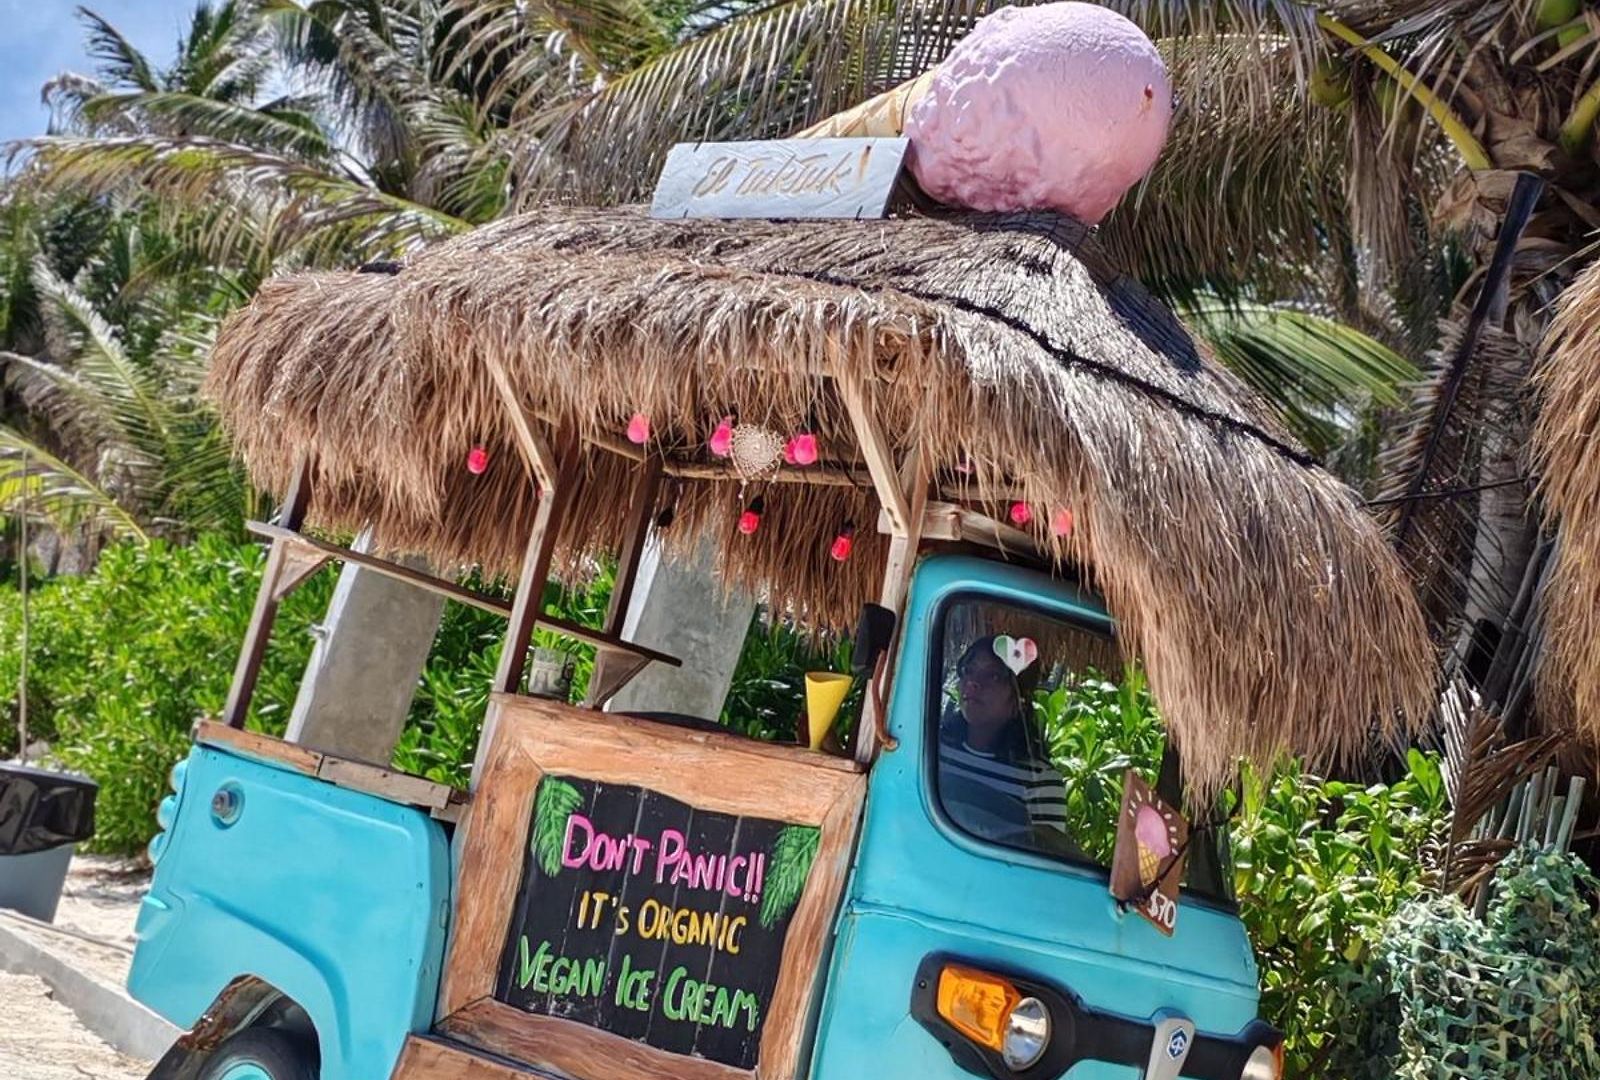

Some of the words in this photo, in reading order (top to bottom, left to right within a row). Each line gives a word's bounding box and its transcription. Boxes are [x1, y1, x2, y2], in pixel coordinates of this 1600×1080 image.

[561, 813, 650, 875] DON'T
[656, 829, 765, 904] PANIC!!
[638, 899, 746, 955] ORGANIC
[520, 935, 606, 998] VEGAN
[615, 954, 655, 1012] ICE
[663, 965, 760, 1032] CREAM
